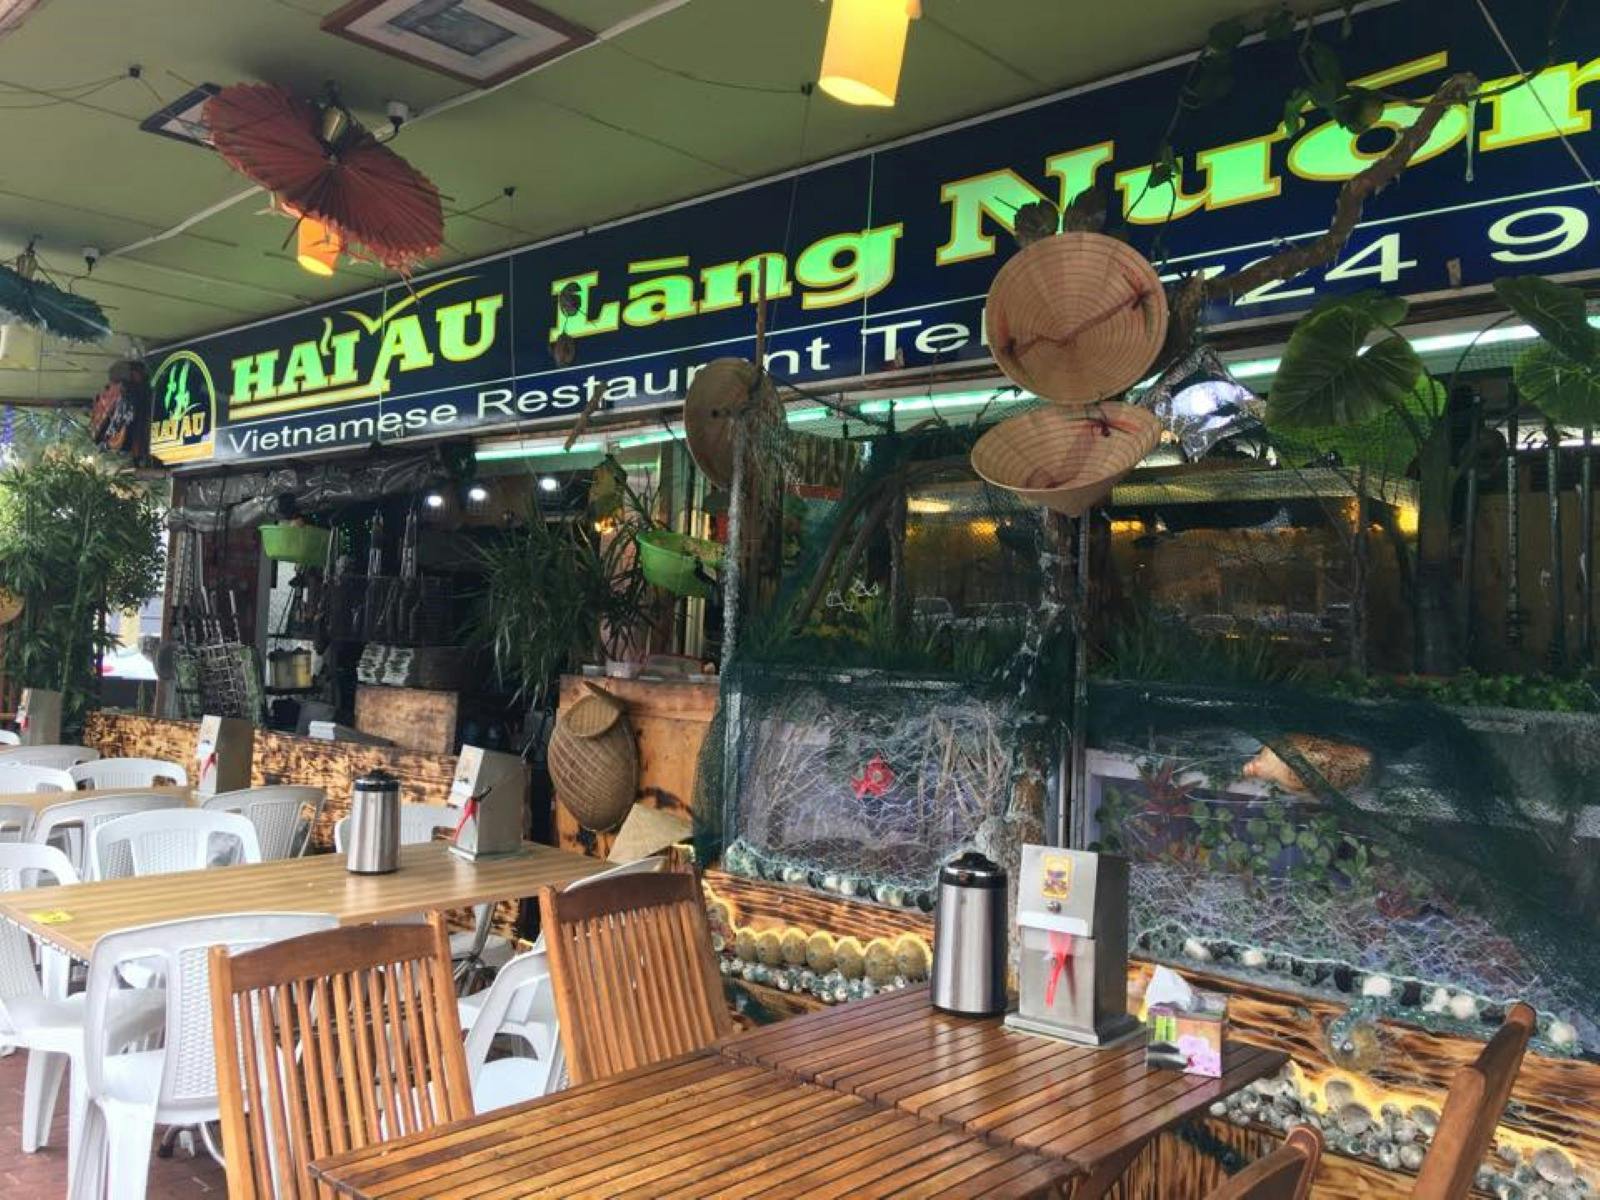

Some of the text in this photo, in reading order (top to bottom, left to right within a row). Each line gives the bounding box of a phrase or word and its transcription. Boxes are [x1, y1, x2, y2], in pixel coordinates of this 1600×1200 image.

[228, 400, 457, 456] Vietnamese
[478, 335, 832, 420] Restaurnt
[1487, 205, 1589, 264] 9
